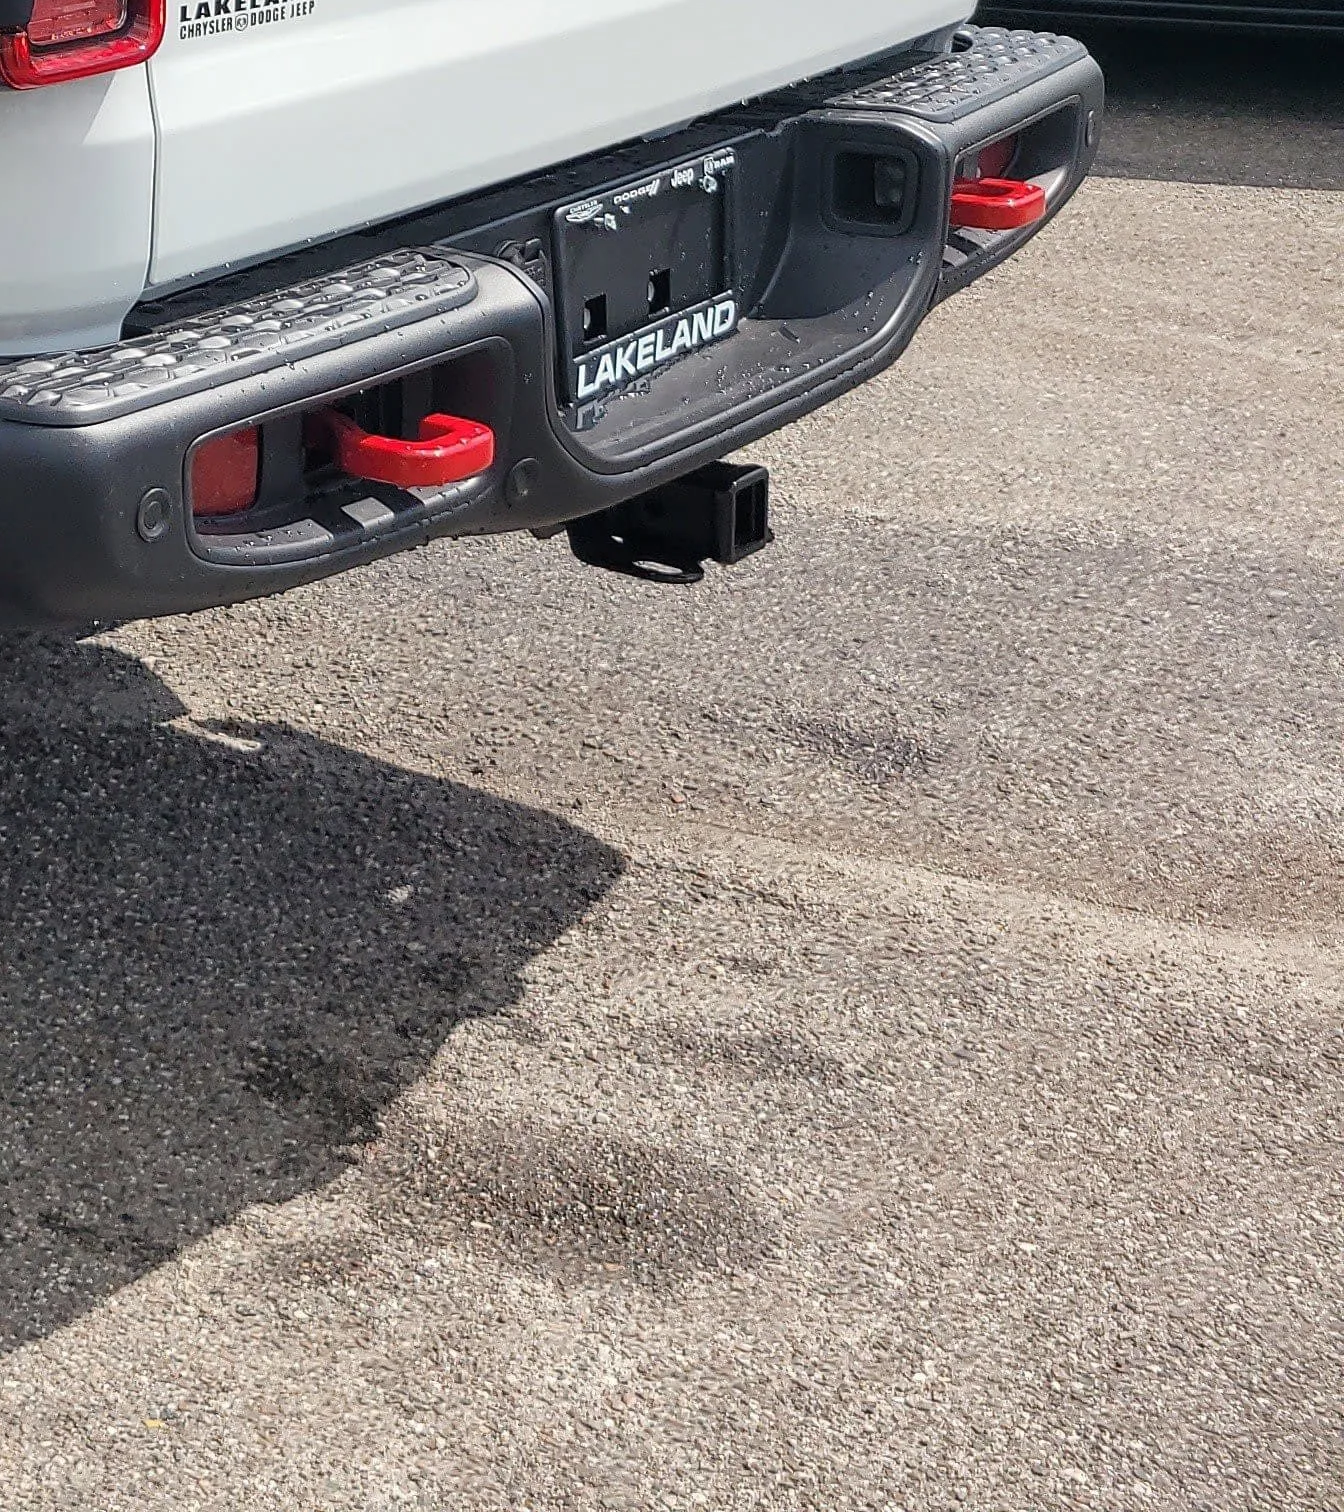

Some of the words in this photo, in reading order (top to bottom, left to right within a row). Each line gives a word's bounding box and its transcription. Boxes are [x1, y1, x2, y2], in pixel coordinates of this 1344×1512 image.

[180, 17, 233, 40] CHRYSLER
[251, 6, 286, 26] DODGE
[290, 0, 315, 18] JEEP
[613, 184, 652, 205] DODGE
[670, 167, 694, 188] Jeep
[713, 155, 735, 170] RAM
[577, 300, 735, 399] LAKELAND
